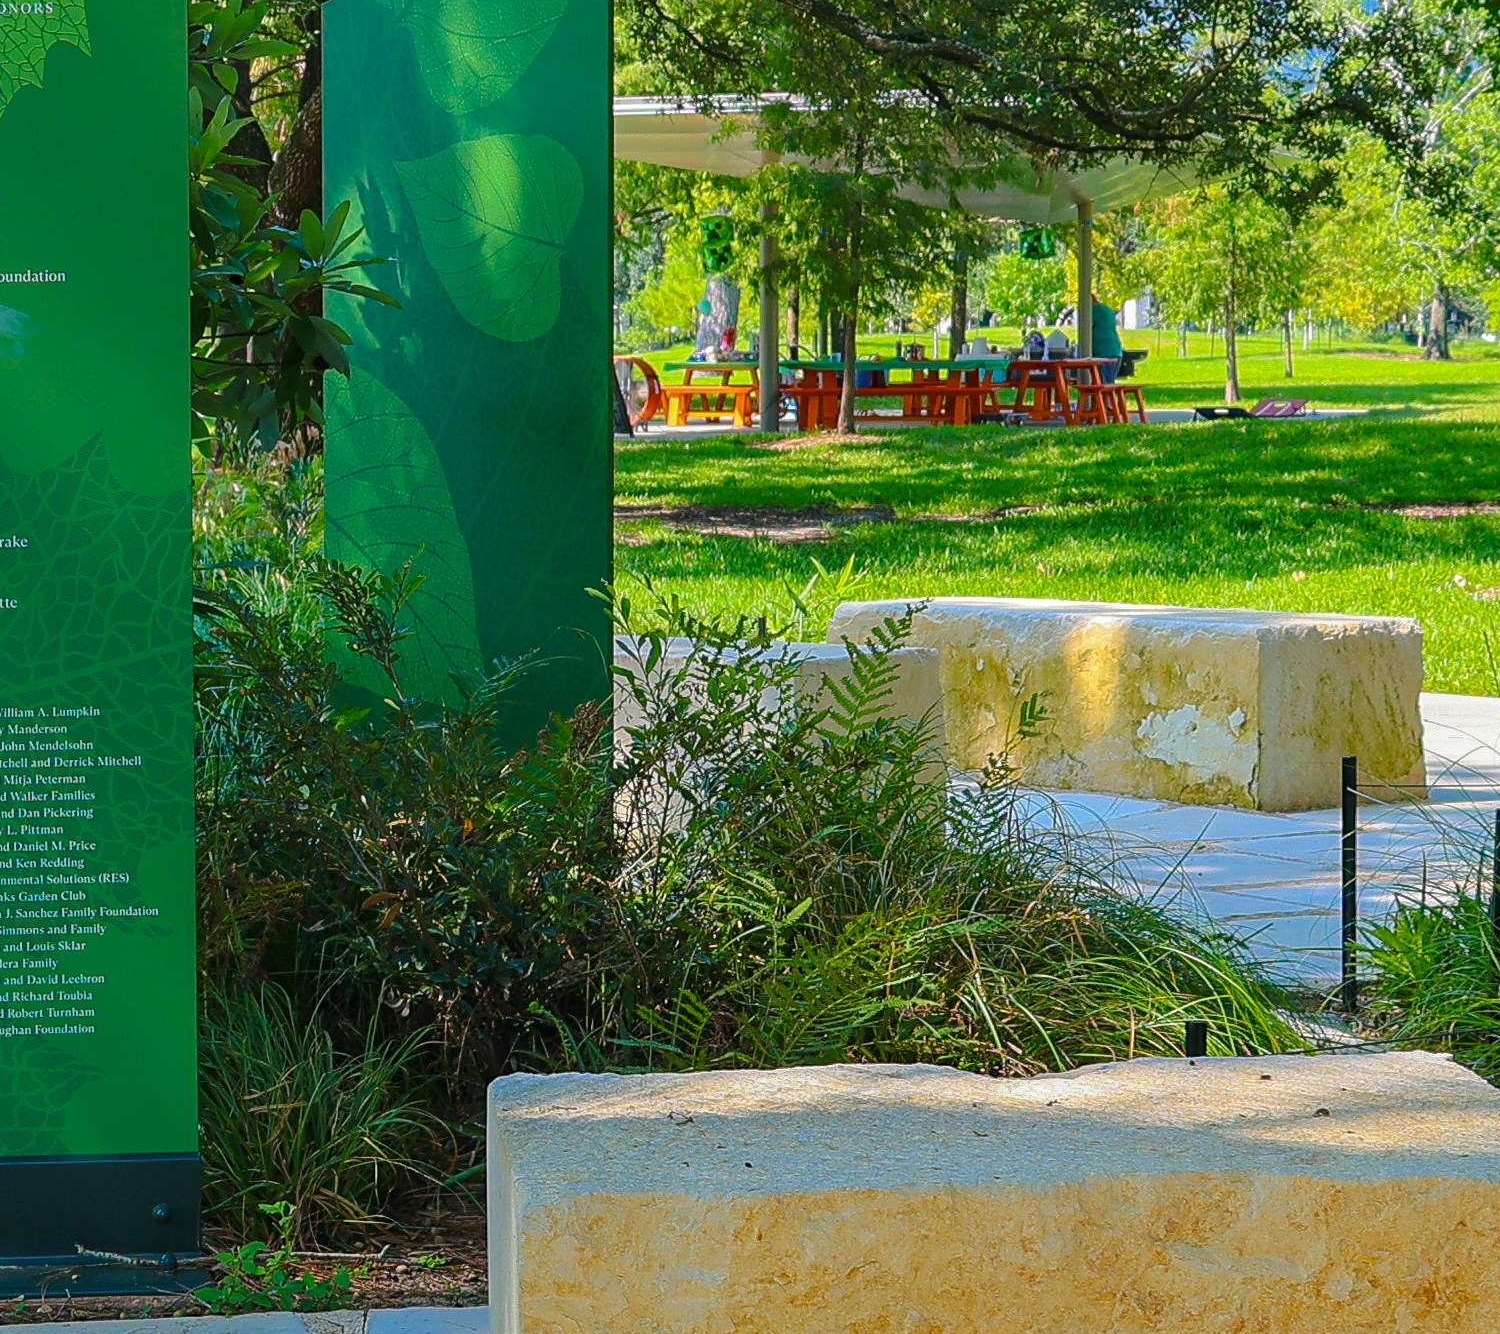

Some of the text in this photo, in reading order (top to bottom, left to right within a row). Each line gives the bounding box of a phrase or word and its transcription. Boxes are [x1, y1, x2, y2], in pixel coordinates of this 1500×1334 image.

[7, 723, 68, 734] Manderson
[0, 740, 26, 751] John
[28, 739, 94, 751] Mendelsohn
[34, 773, 86, 784] Peterman
[9, 790, 48, 801] Walker
[50, 789, 96, 800] Families
[20, 824, 64, 835] Pittman
[46, 873, 96, 884] Solutions
[98, 872, 130, 883] (RES)
[18, 891, 58, 901] Garden
[60, 890, 86, 900] Club
[22, 957, 58, 971] Family
[12, 991, 54, 1001] Richard
[34, 1023, 95, 1034] Foundation
